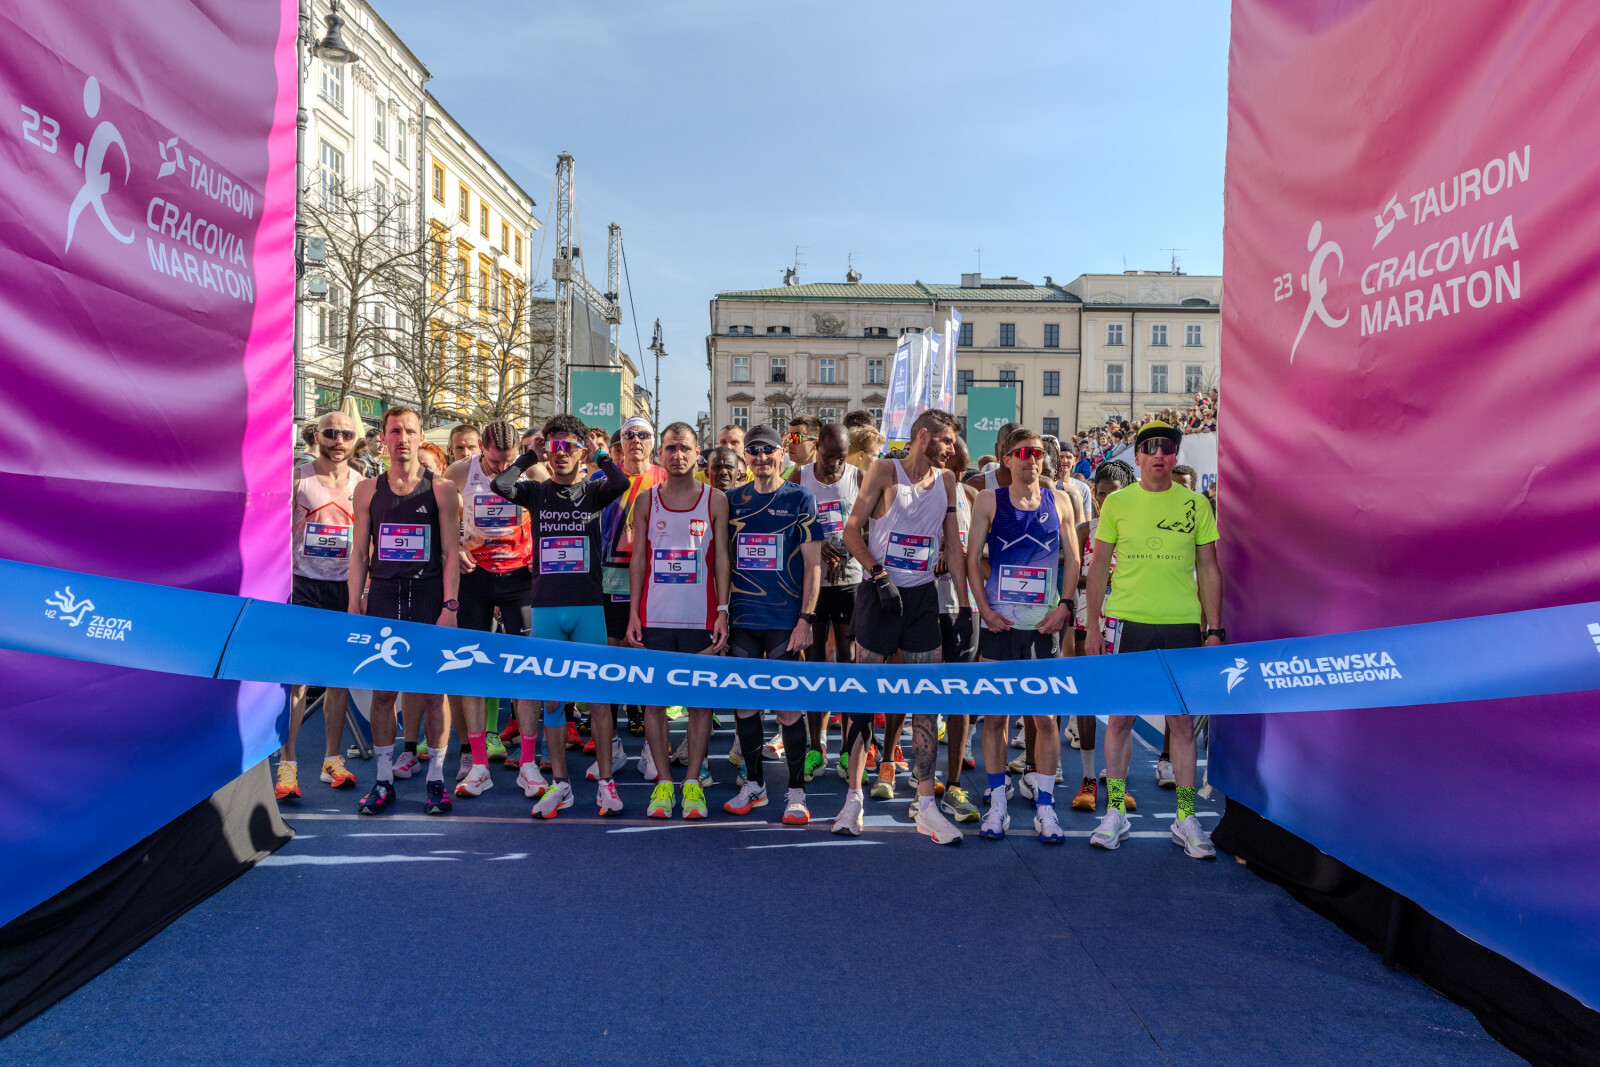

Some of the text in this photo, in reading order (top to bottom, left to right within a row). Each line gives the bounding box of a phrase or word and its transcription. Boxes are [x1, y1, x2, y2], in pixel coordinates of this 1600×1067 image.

[20, 104, 61, 154] 23
[188, 155, 254, 220] TAURON
[1409, 144, 1531, 226] TAURON
[147, 197, 248, 268] CRACOVIA
[1360, 214, 1520, 296] CRACOVIA
[147, 237, 254, 304] MARATON
[1273, 272, 1293, 302] 23
[1360, 260, 1521, 337] MARATON
[578, 402, 614, 416] <2:50
[487, 507, 504, 516] 27
[539, 510, 593, 521] Koryo Car
[540, 521, 586, 532] Hyundai
[318, 537, 337, 546] 95
[394, 538, 409, 547] 91
[558, 550, 567, 560] 3
[746, 547, 766, 556] 128
[903, 547, 916, 558] 12
[668, 562, 682, 572] 16
[1019, 580, 1028, 590] 7
[44, 609, 56, 620] 42
[89, 615, 132, 632] ZŁOTA
[86, 626, 126, 642] SERIA
[346, 632, 372, 645] 23
[1259, 651, 1396, 678] KRÓLEWSKA
[499, 652, 1079, 695] TAURON CRACOVIA MARATON
[1264, 667, 1403, 690] TRIADA BIEGOWA
